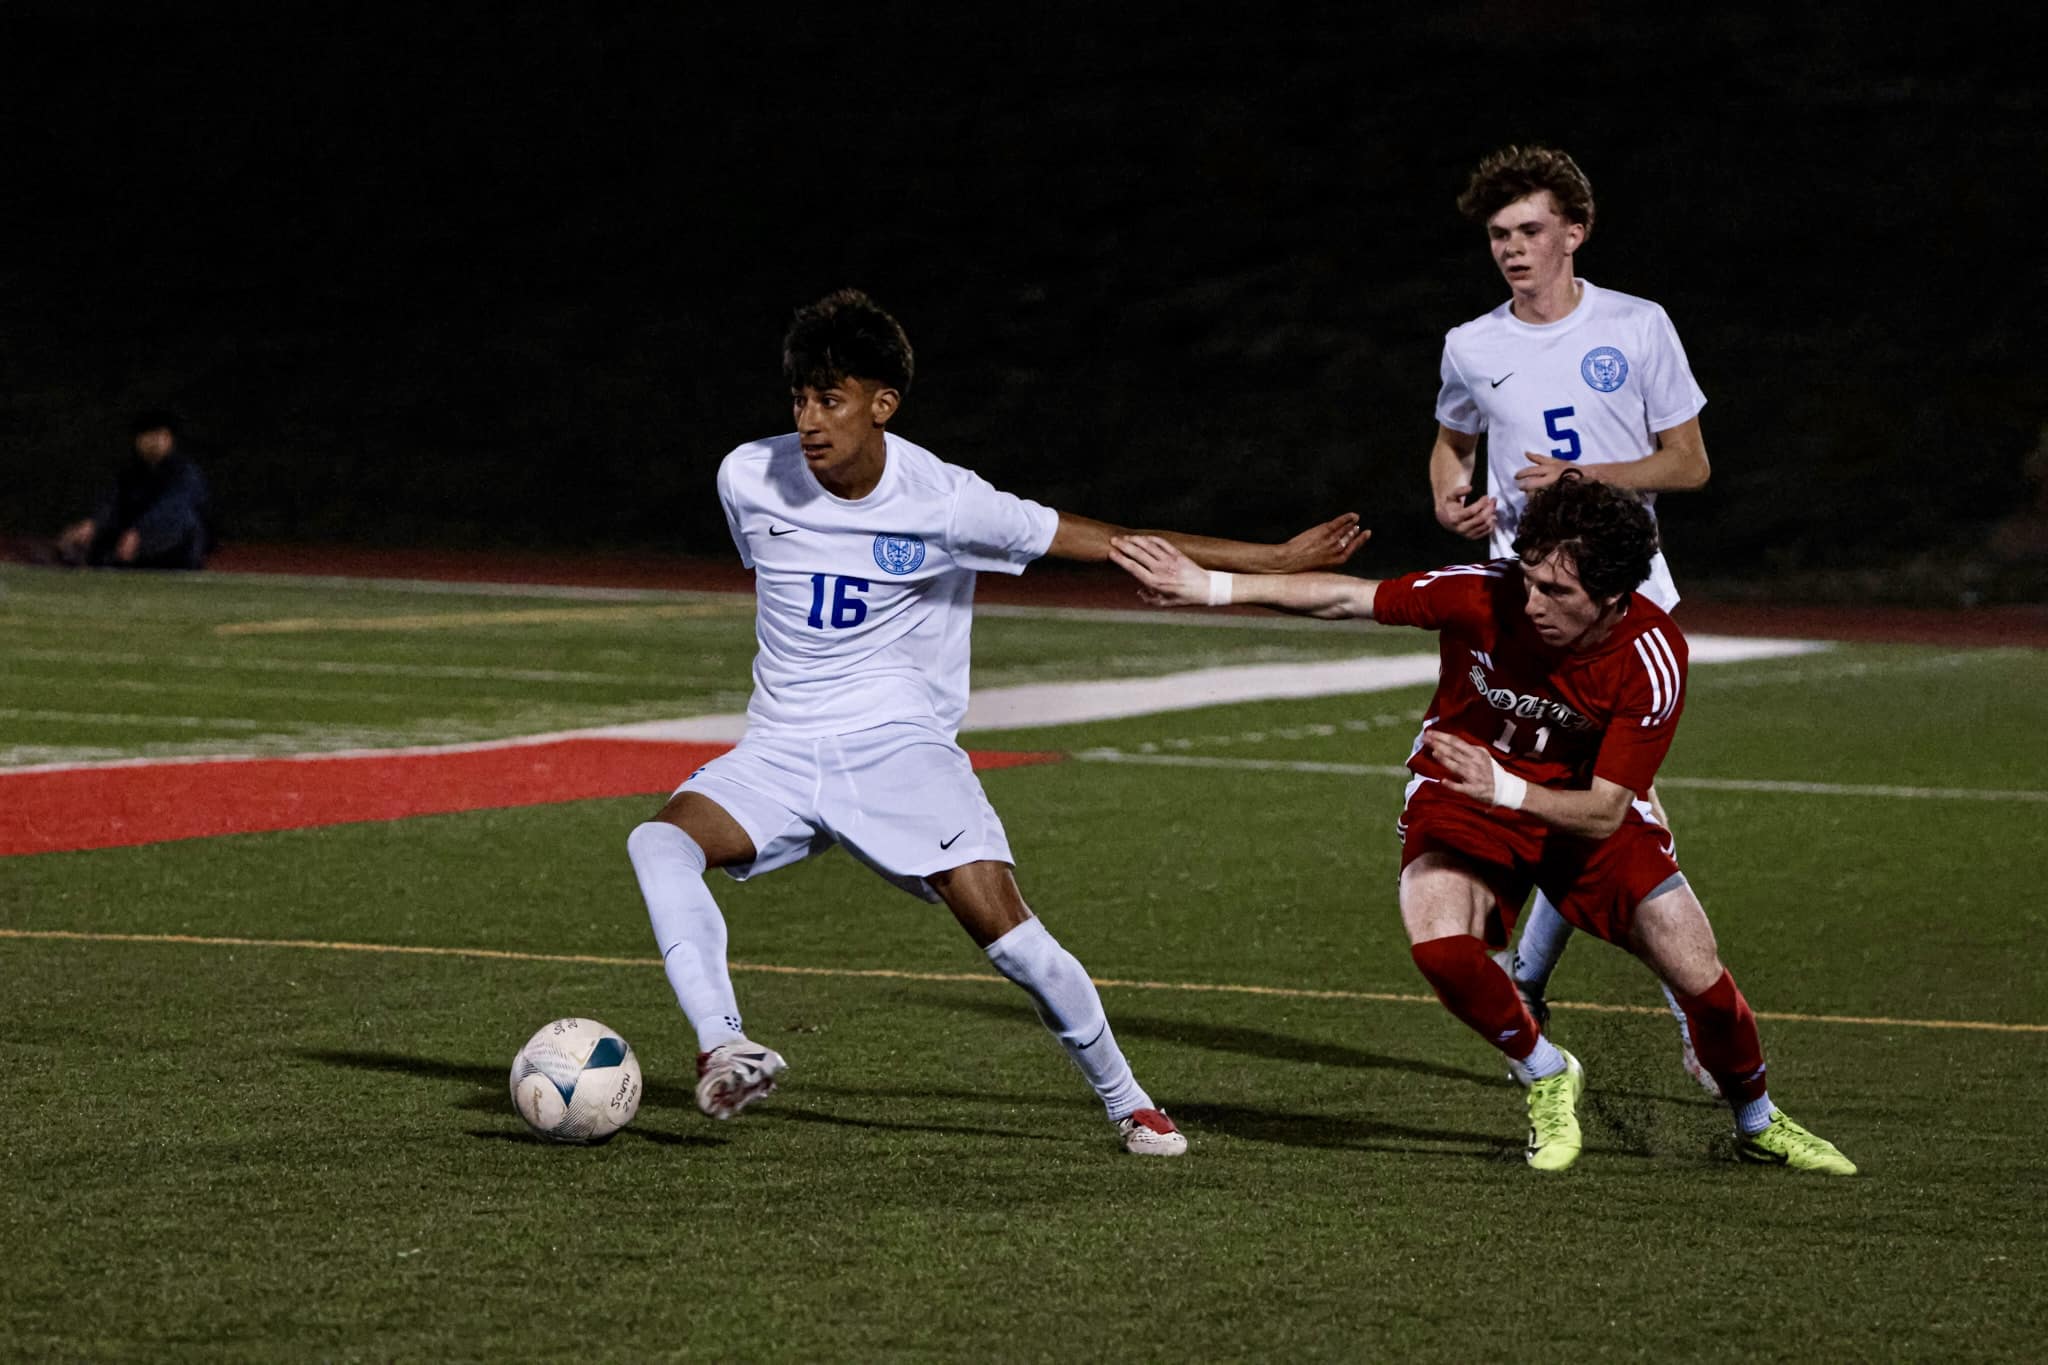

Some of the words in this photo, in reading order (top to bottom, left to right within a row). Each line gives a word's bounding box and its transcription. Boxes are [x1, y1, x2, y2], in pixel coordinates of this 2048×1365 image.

[1544, 406, 1581, 461] 5
[808, 574, 869, 629] 16
[1493, 719, 1551, 759] 11
